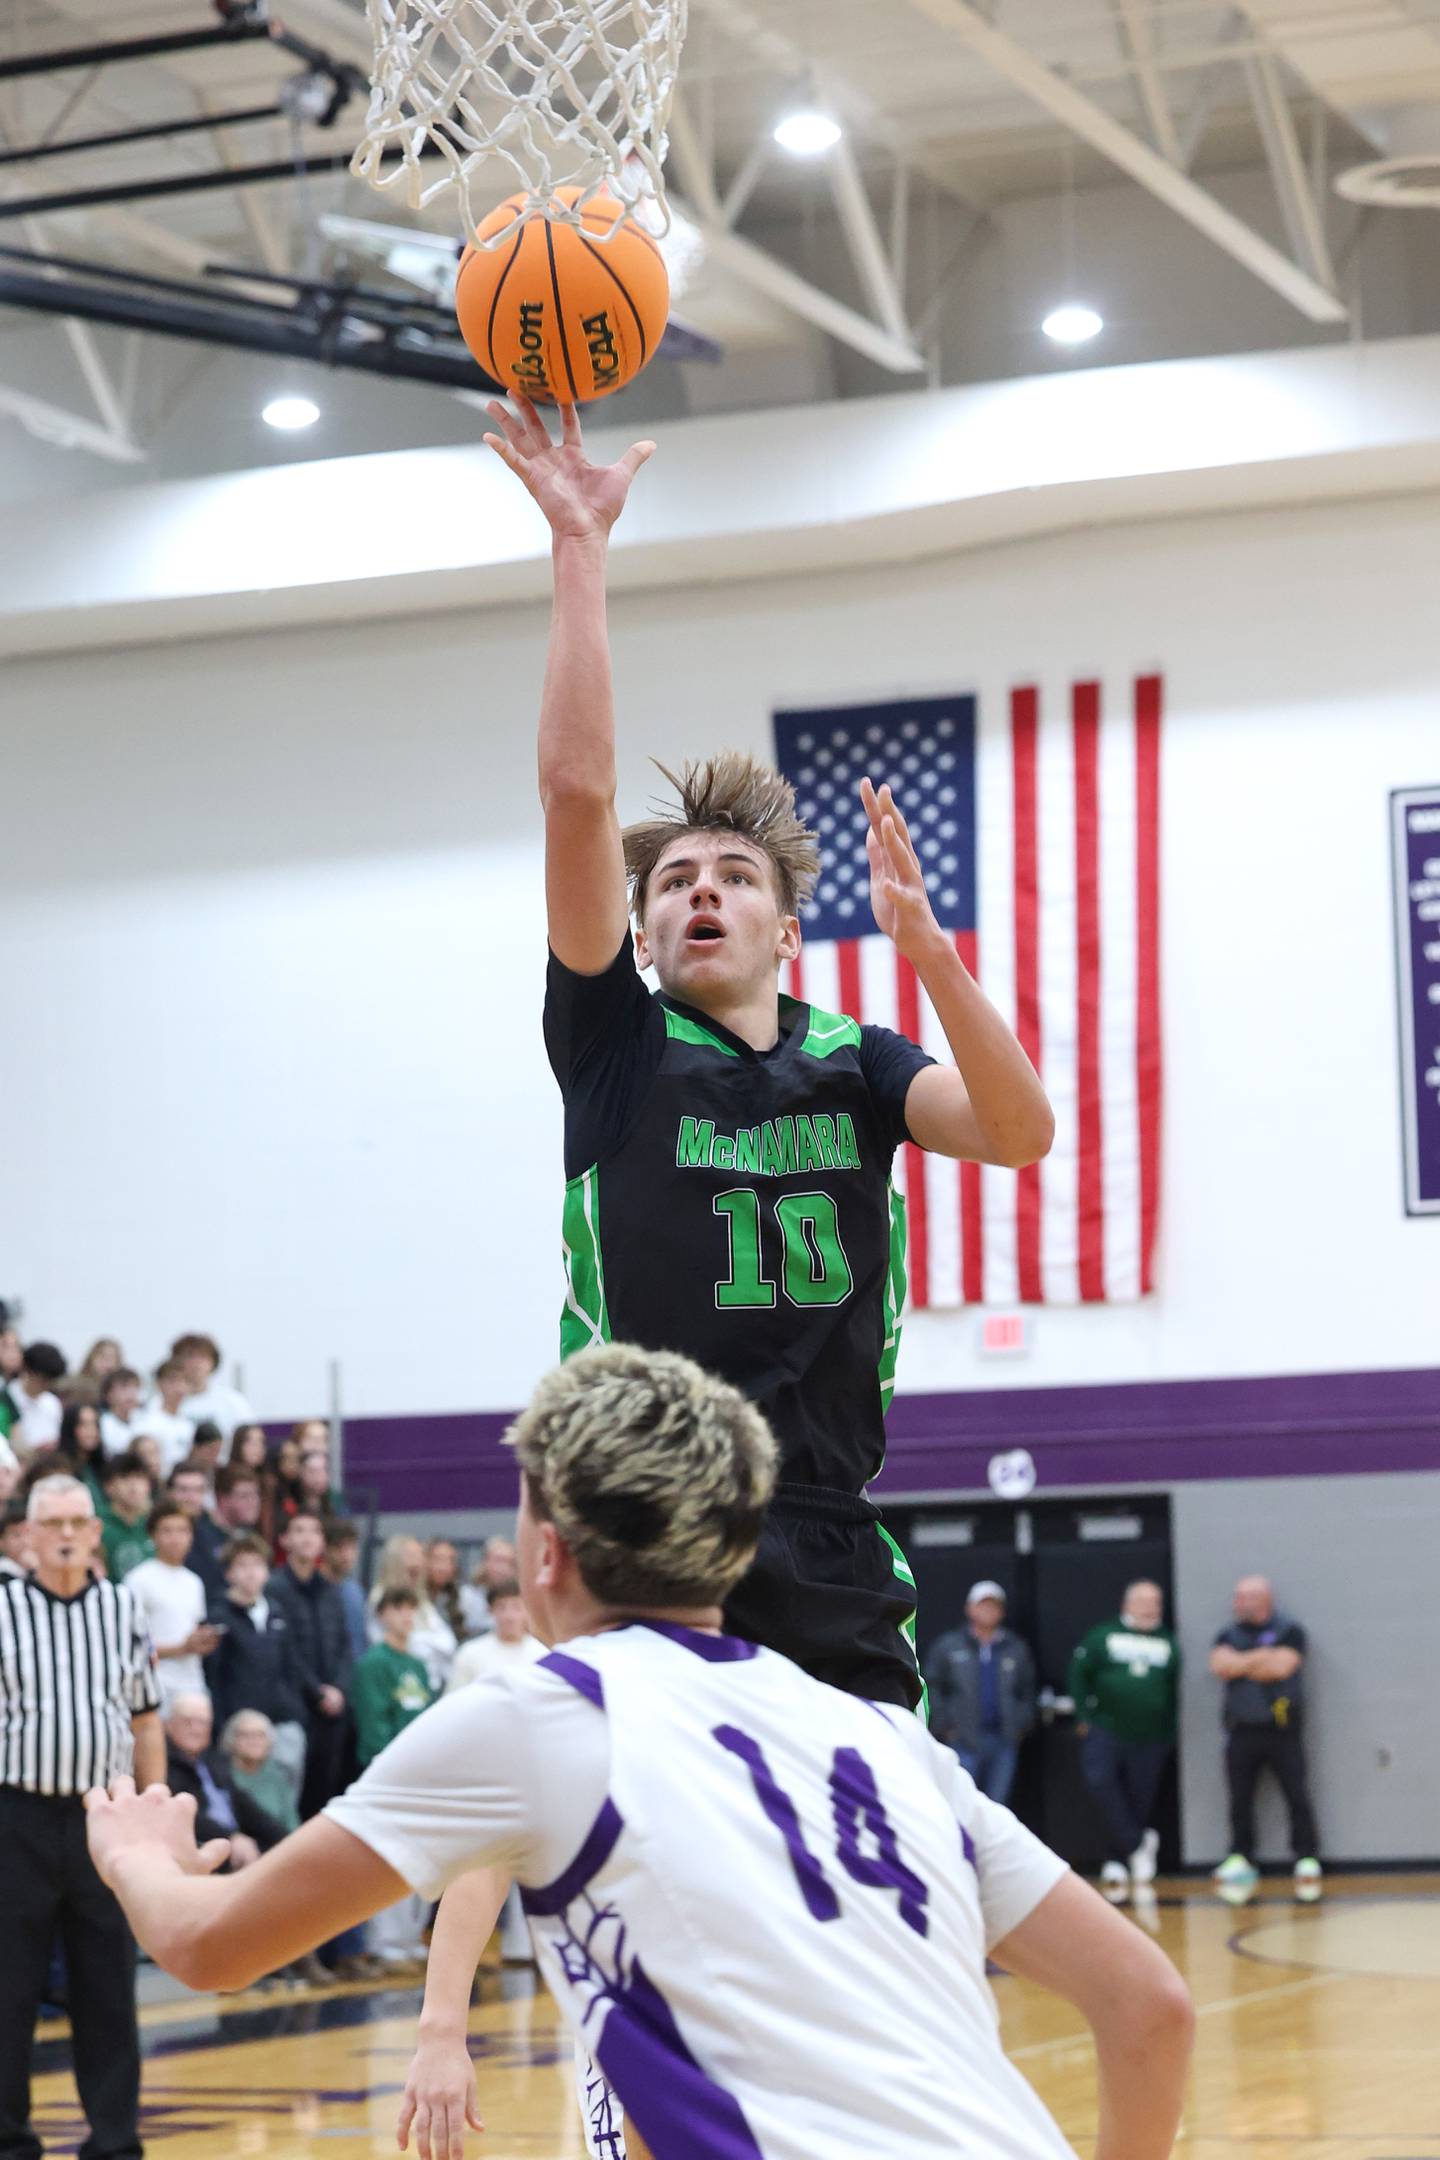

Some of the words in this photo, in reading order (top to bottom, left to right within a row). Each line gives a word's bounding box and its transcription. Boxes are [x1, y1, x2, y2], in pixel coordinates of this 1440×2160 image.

[580, 310, 619, 391] NCAA
[712, 1187, 854, 1309] 10
[710, 1723, 929, 1940] 14
